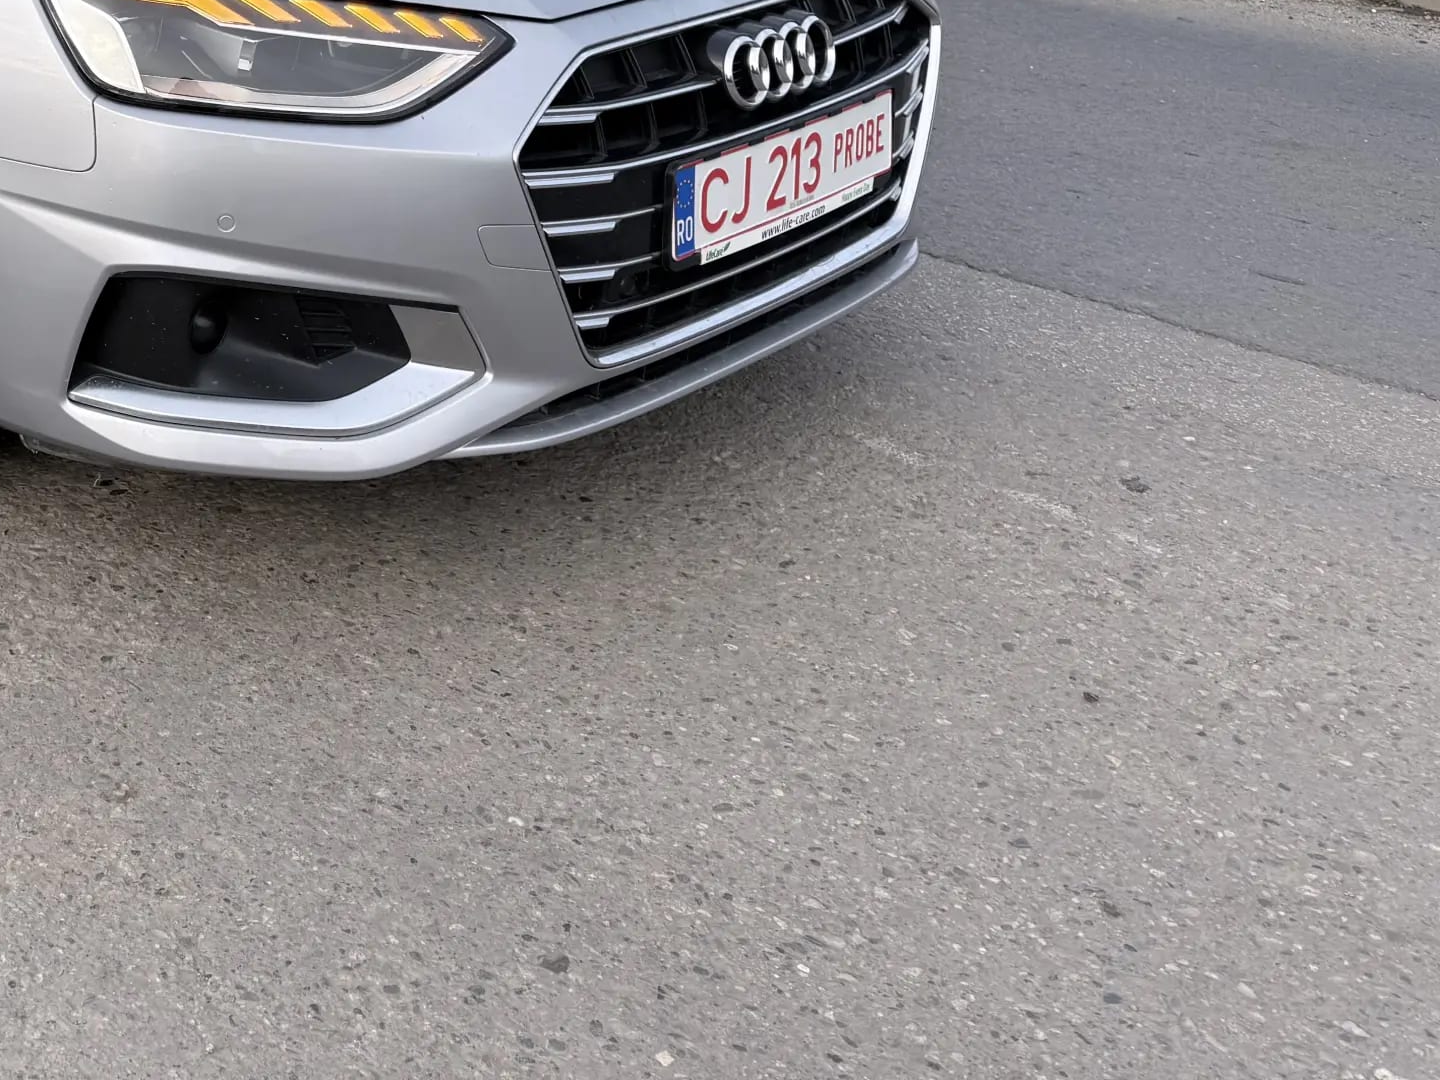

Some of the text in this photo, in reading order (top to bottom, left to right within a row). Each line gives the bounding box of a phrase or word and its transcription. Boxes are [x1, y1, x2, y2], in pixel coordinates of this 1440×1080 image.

[700, 113, 885, 233] CJ 213 PROBE
[676, 215, 694, 247] RO
[761, 204, 826, 240] www.life-care.com
